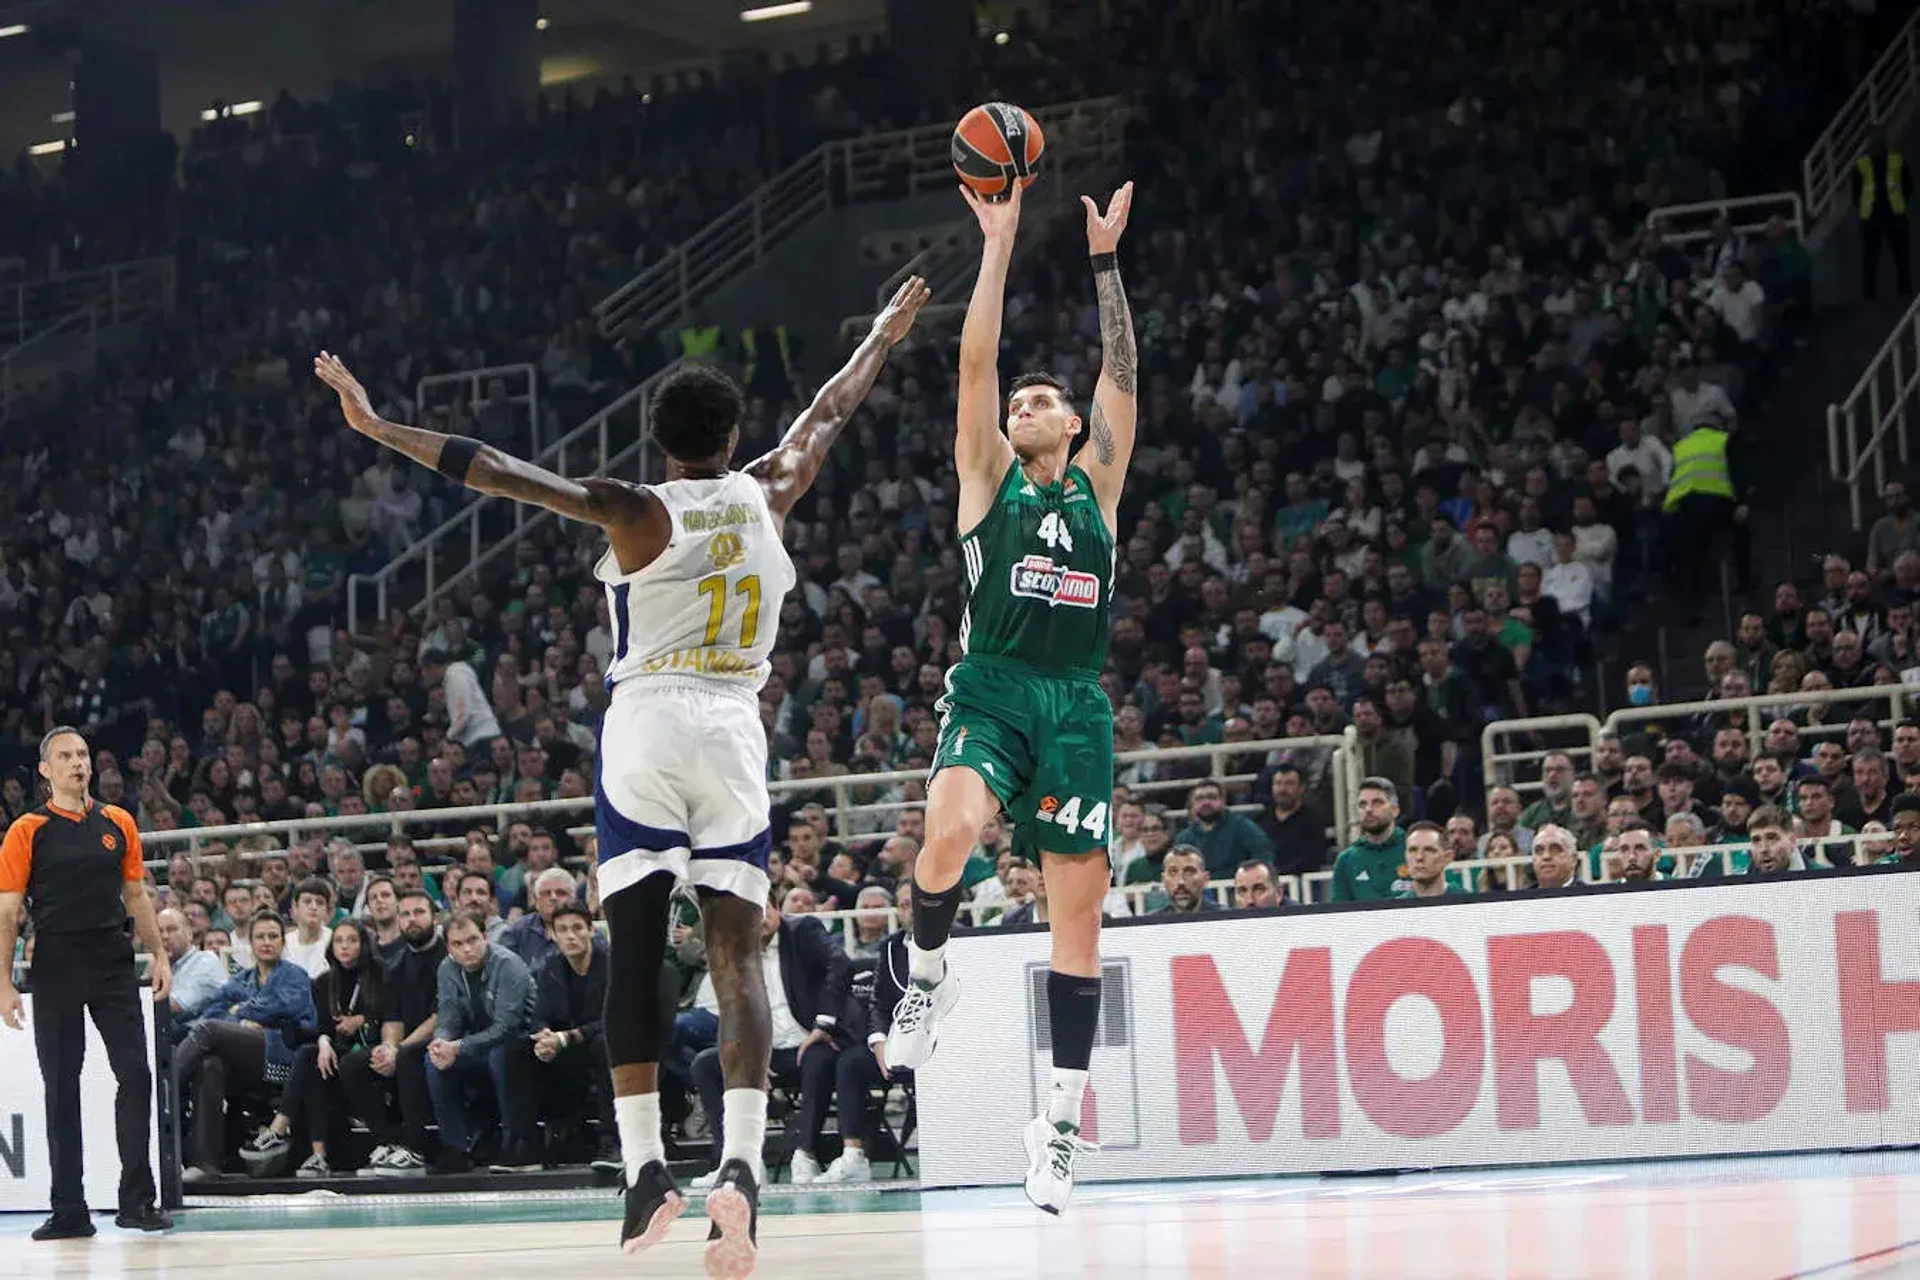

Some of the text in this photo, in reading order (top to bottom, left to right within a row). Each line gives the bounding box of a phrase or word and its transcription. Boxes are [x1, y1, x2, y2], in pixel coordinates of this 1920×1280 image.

[698, 574, 761, 649] 11
[1055, 796, 1107, 840] 44
[1170, 914, 1791, 1145] MORIS
